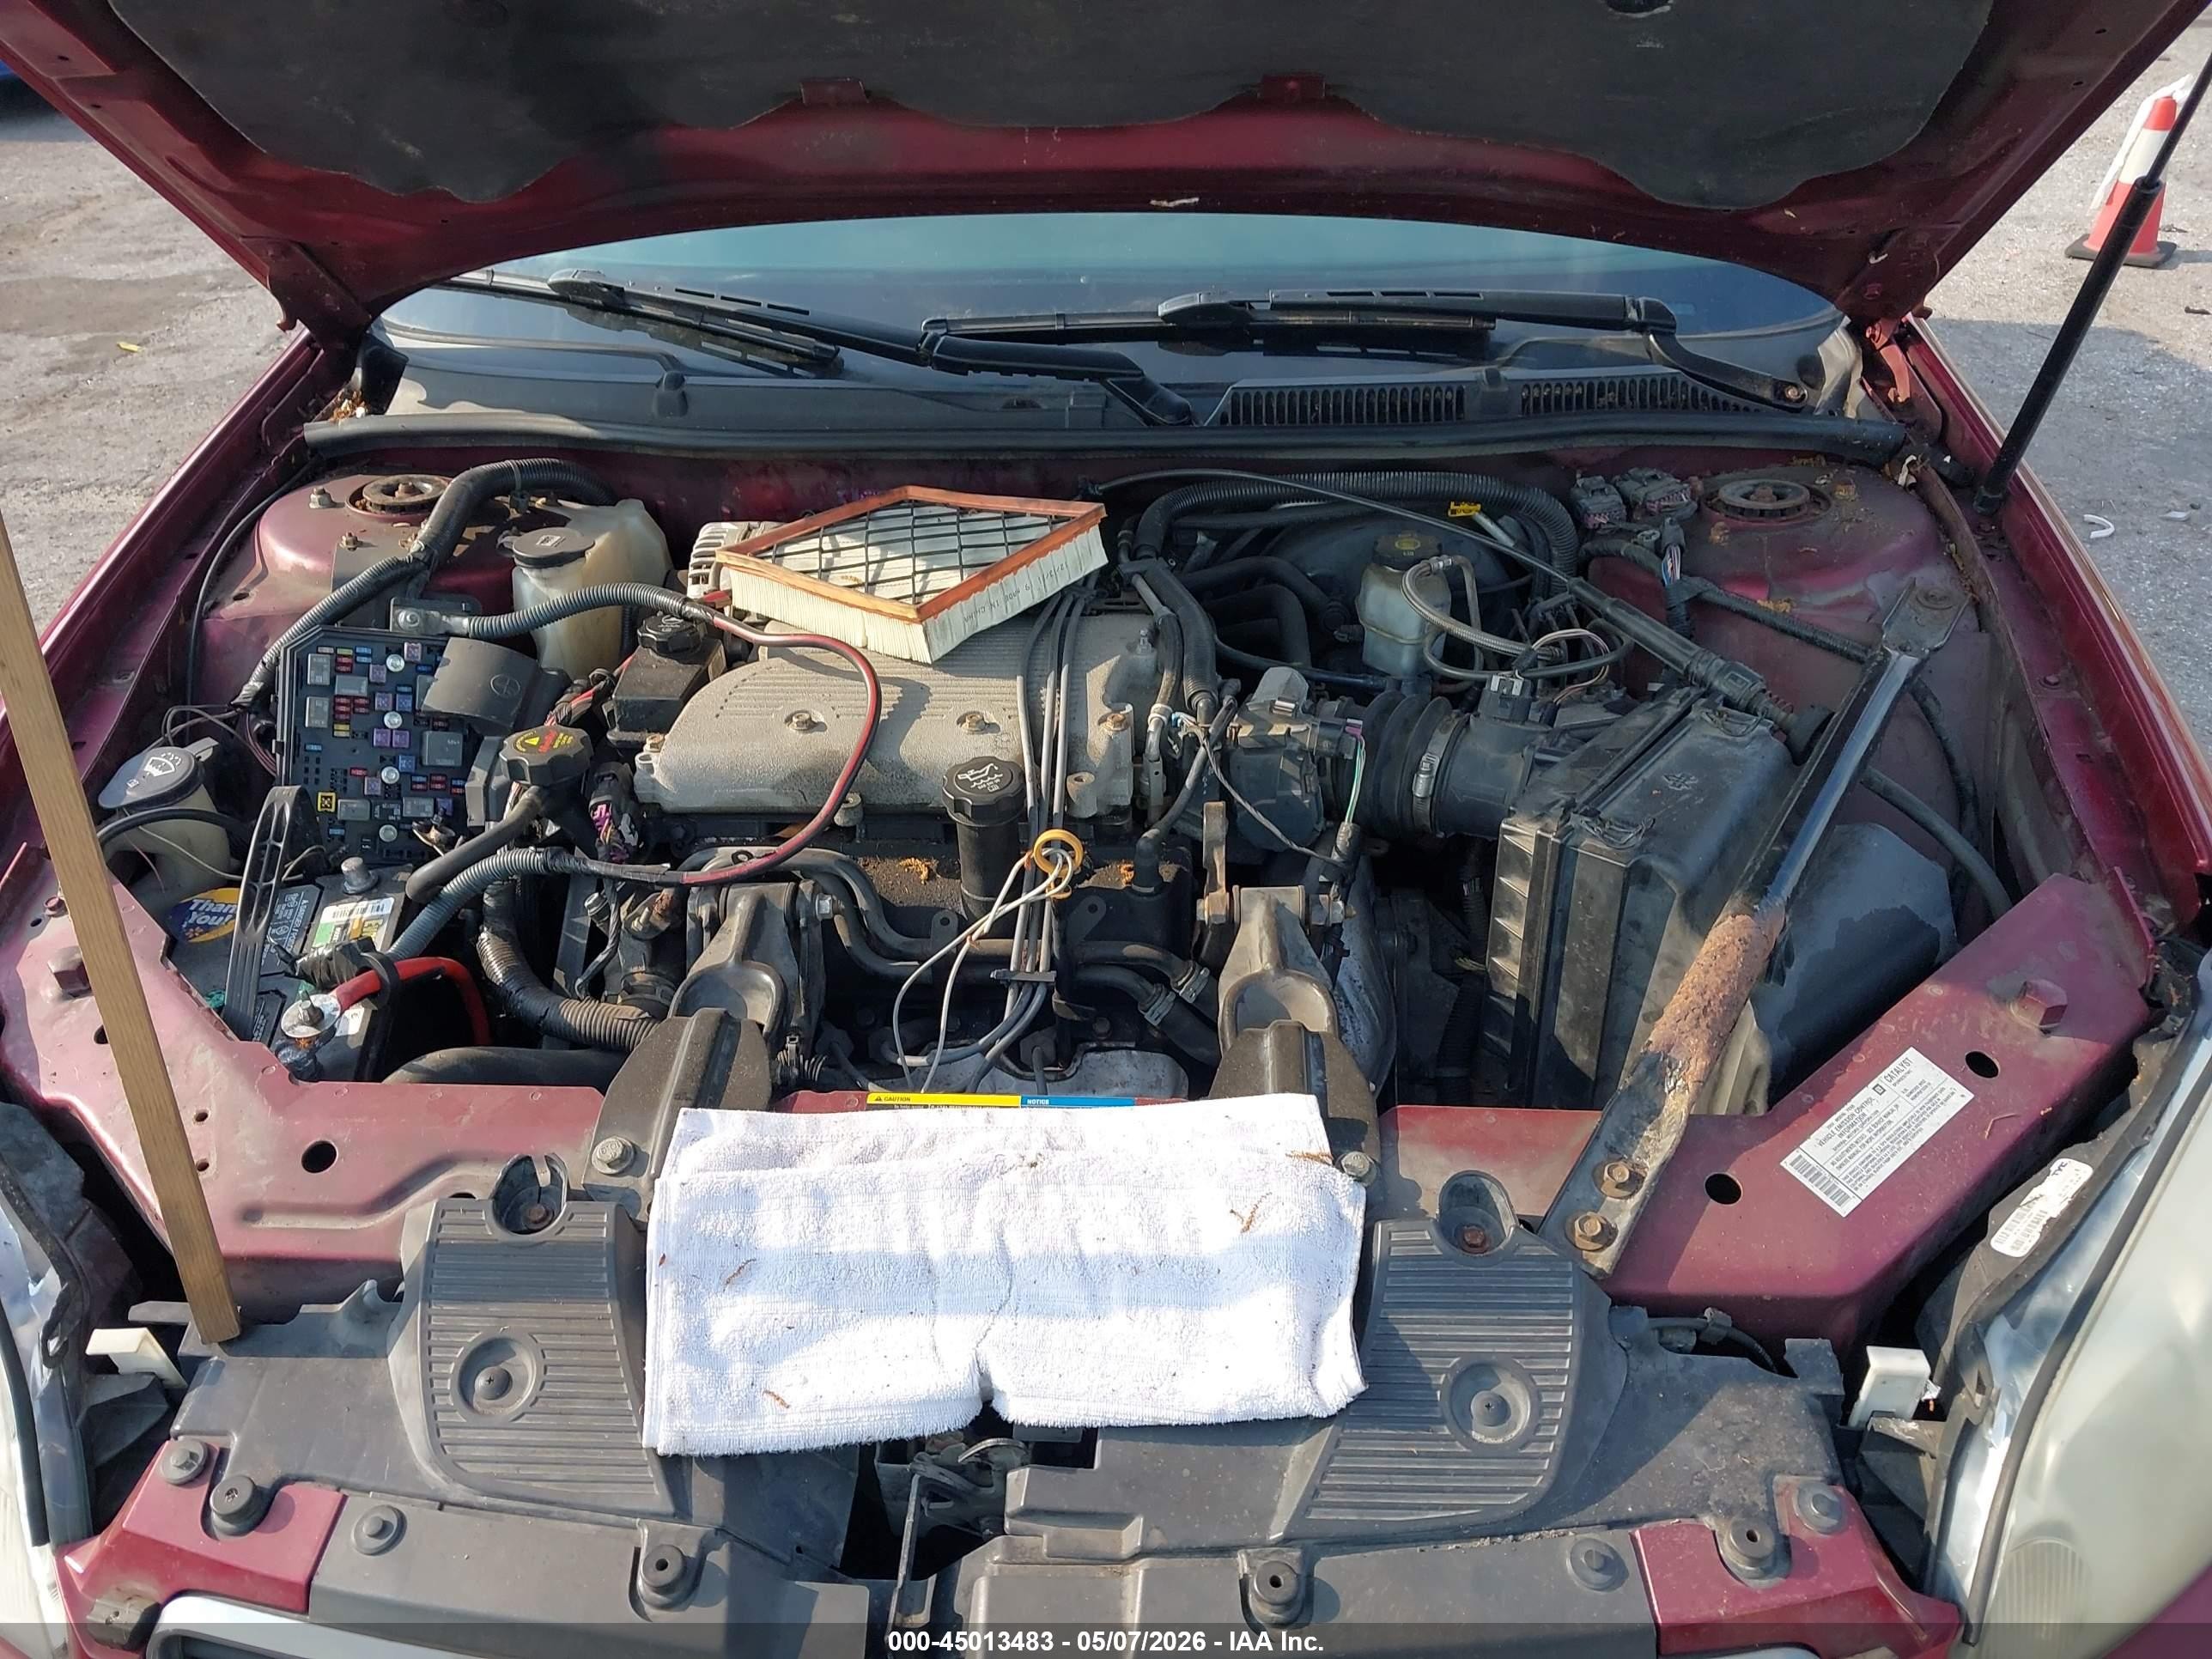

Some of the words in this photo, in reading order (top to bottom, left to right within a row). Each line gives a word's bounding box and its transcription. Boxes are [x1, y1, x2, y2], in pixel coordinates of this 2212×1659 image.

[1004, 588, 1021, 602] MADE
[990, 599, 1000, 610] IN
[963, 606, 986, 623] CHINA
[189, 898, 238, 914] Than
[188, 911, 233, 926] You!
[1882, 1056, 1913, 1083] CATALYST
[1816, 1129, 1836, 1146] VEHICLE
[1833, 1111, 1856, 1132] EMISSION
[1853, 1095, 1875, 1115] CONTROL
[1836, 1111, 1867, 1139] INFORMATION
[2051, 1161, 2069, 1176] TYC
